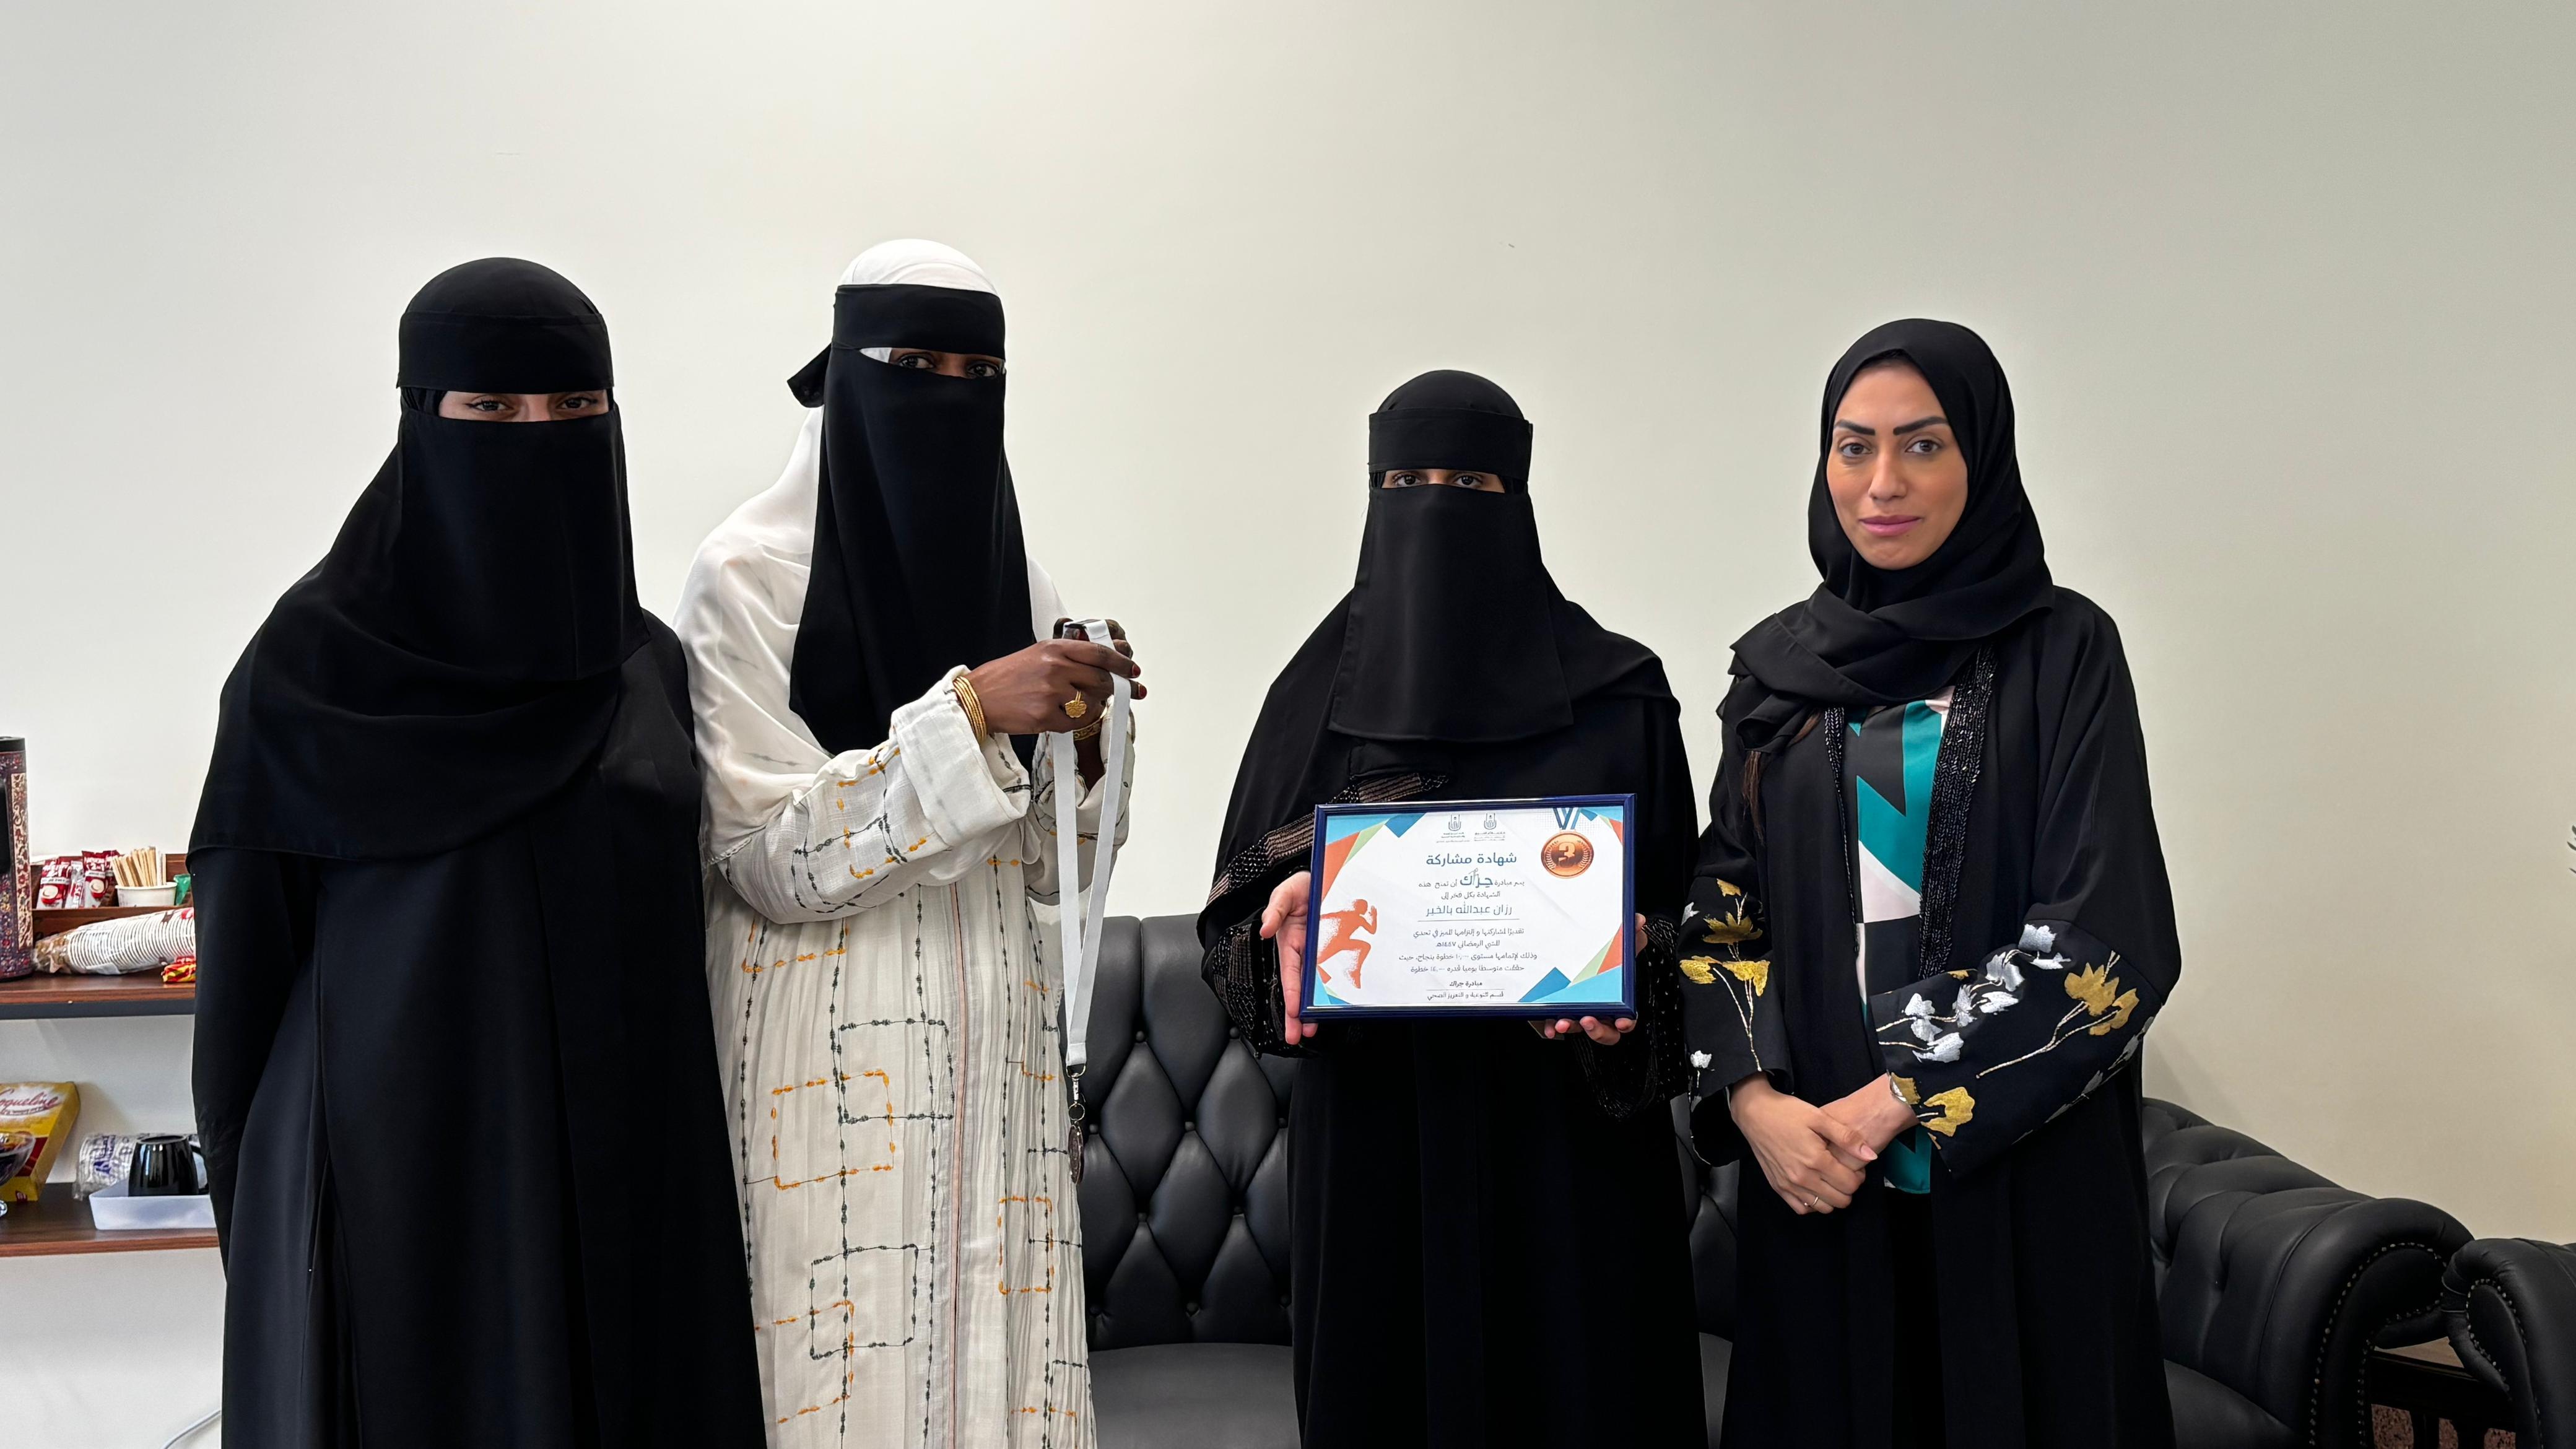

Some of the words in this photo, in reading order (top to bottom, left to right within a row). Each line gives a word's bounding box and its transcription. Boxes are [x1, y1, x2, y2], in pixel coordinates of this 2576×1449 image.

[1426, 853, 1472, 867] مشاركة
[1477, 852, 1516, 866] شهادة
[1426, 905, 1452, 916] بالخير
[1494, 905, 1512, 915] رزان
